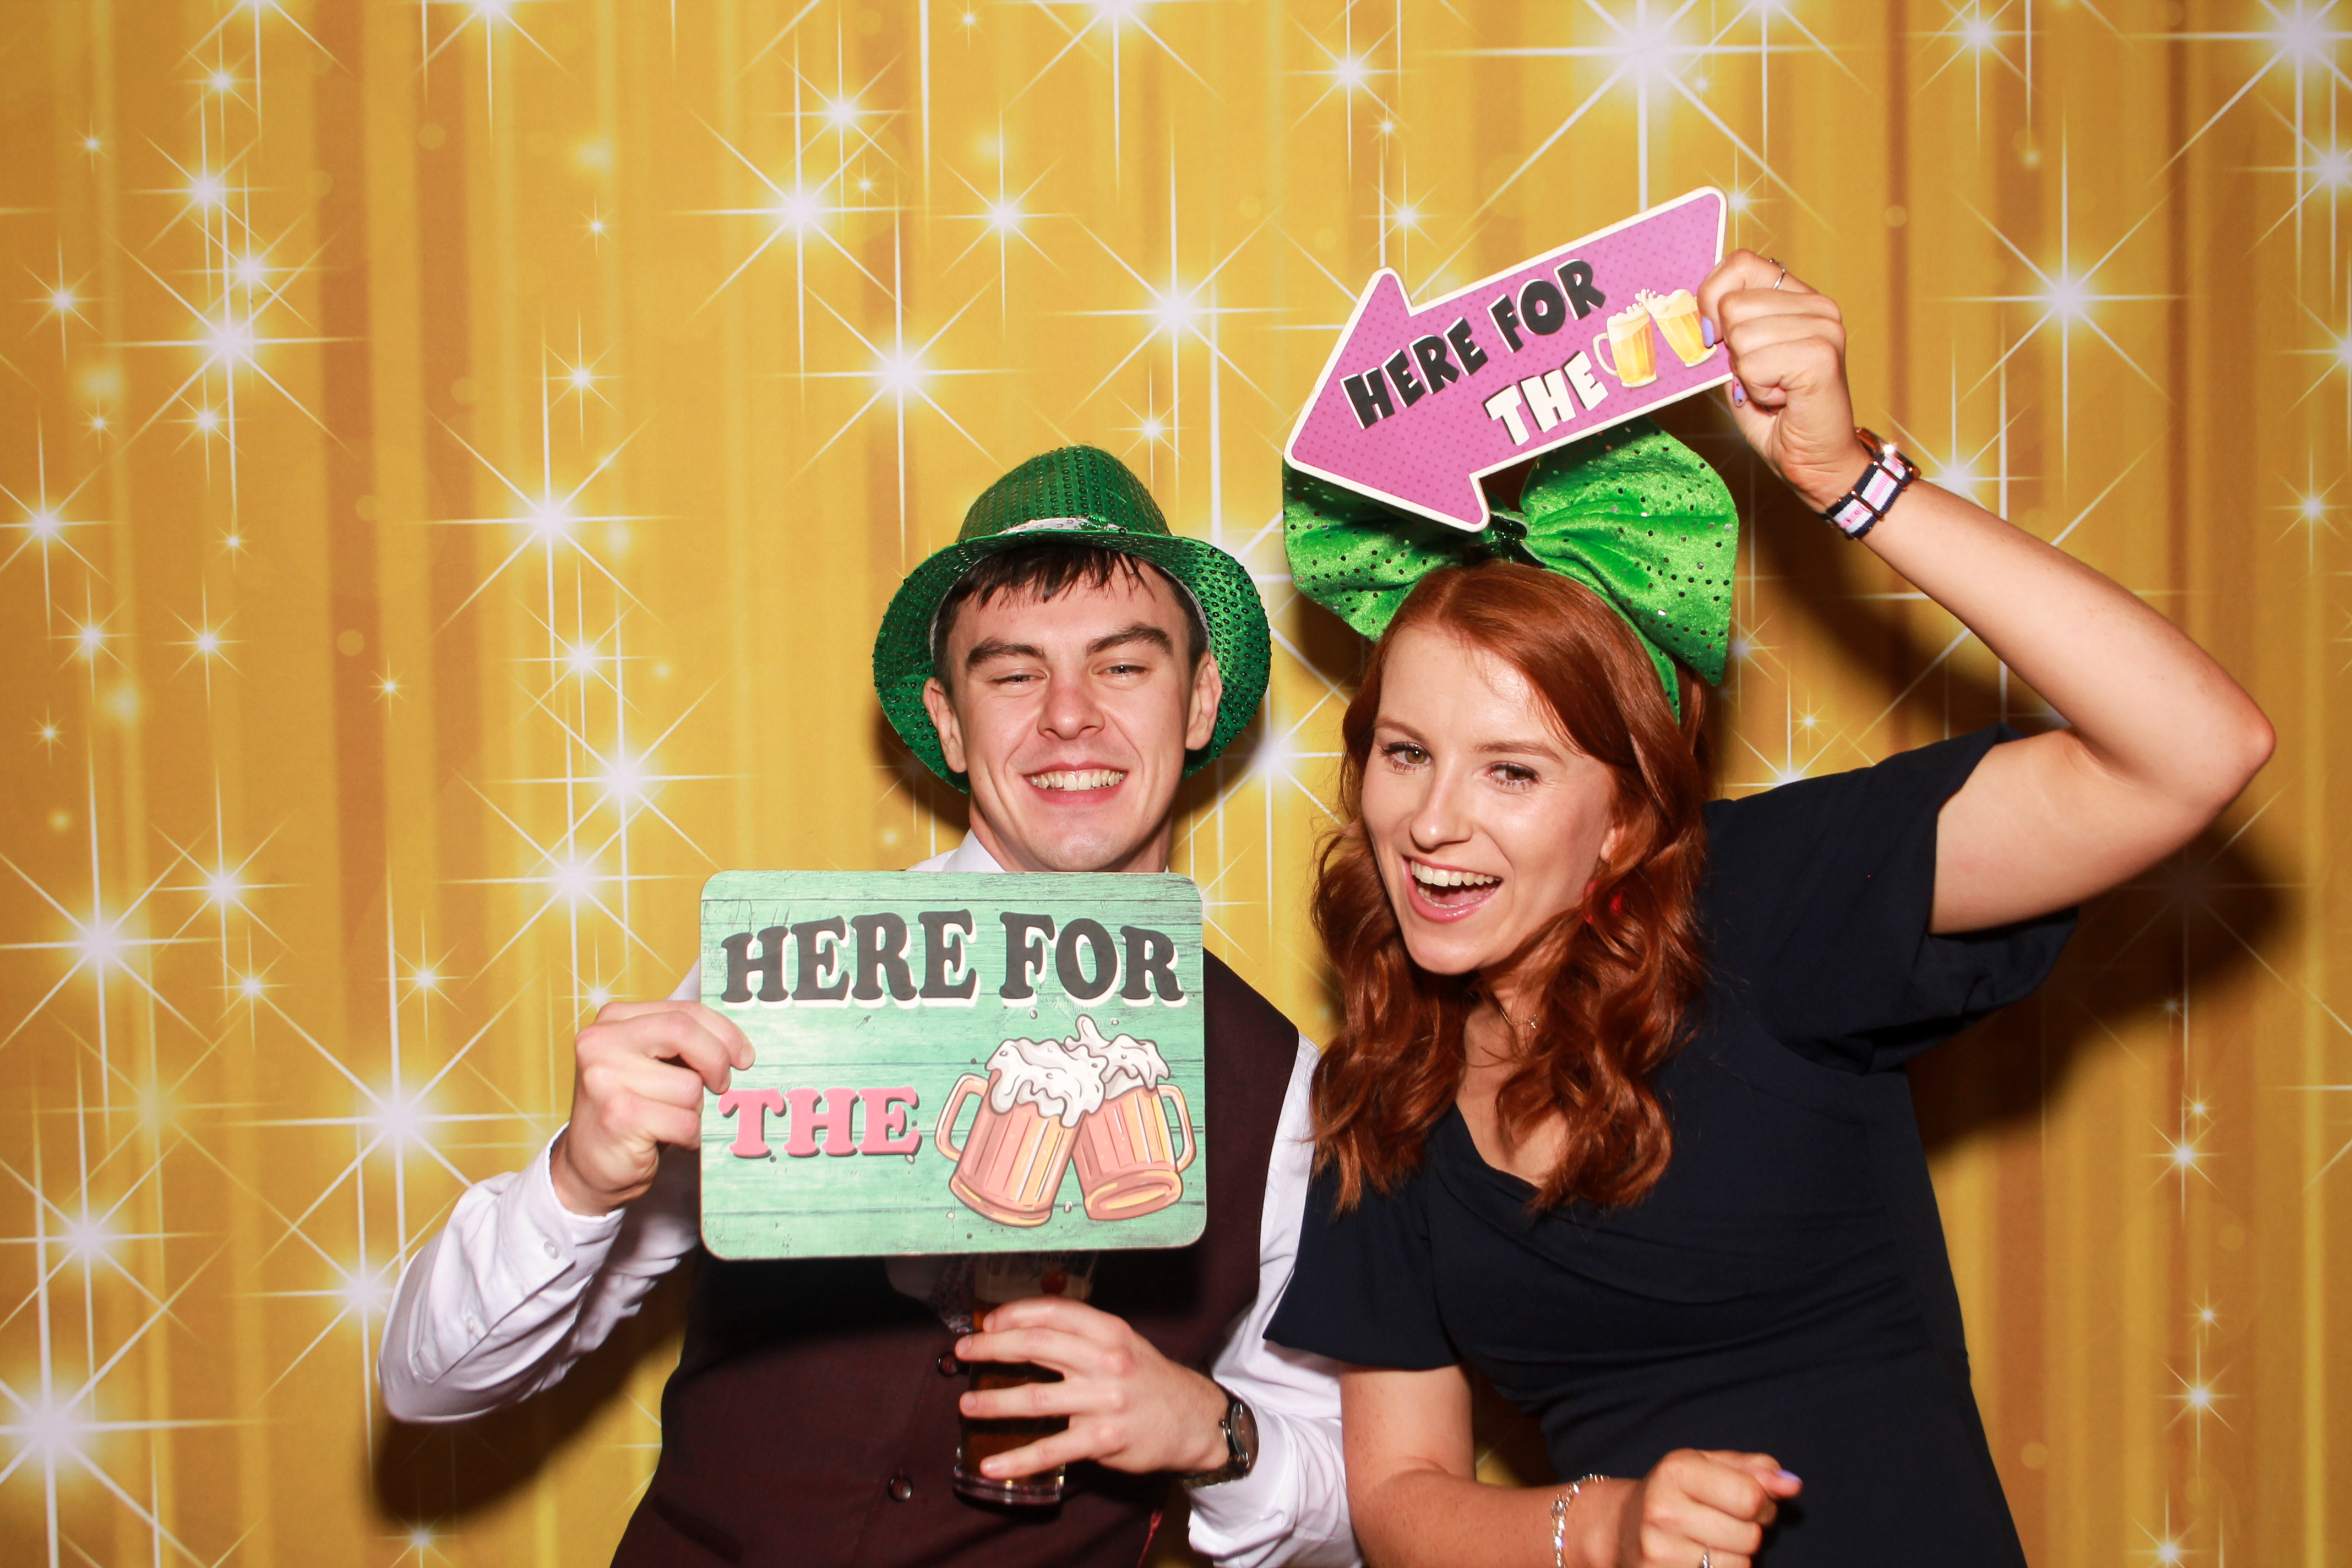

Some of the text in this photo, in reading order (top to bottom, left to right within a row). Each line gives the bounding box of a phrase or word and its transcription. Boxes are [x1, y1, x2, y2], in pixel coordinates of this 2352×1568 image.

[1340, 259, 1606, 429] HERE FOR
[1482, 350, 1609, 447] THE
[721, 909, 1187, 1008] HERE FOR
[717, 1085, 922, 1159] THE
